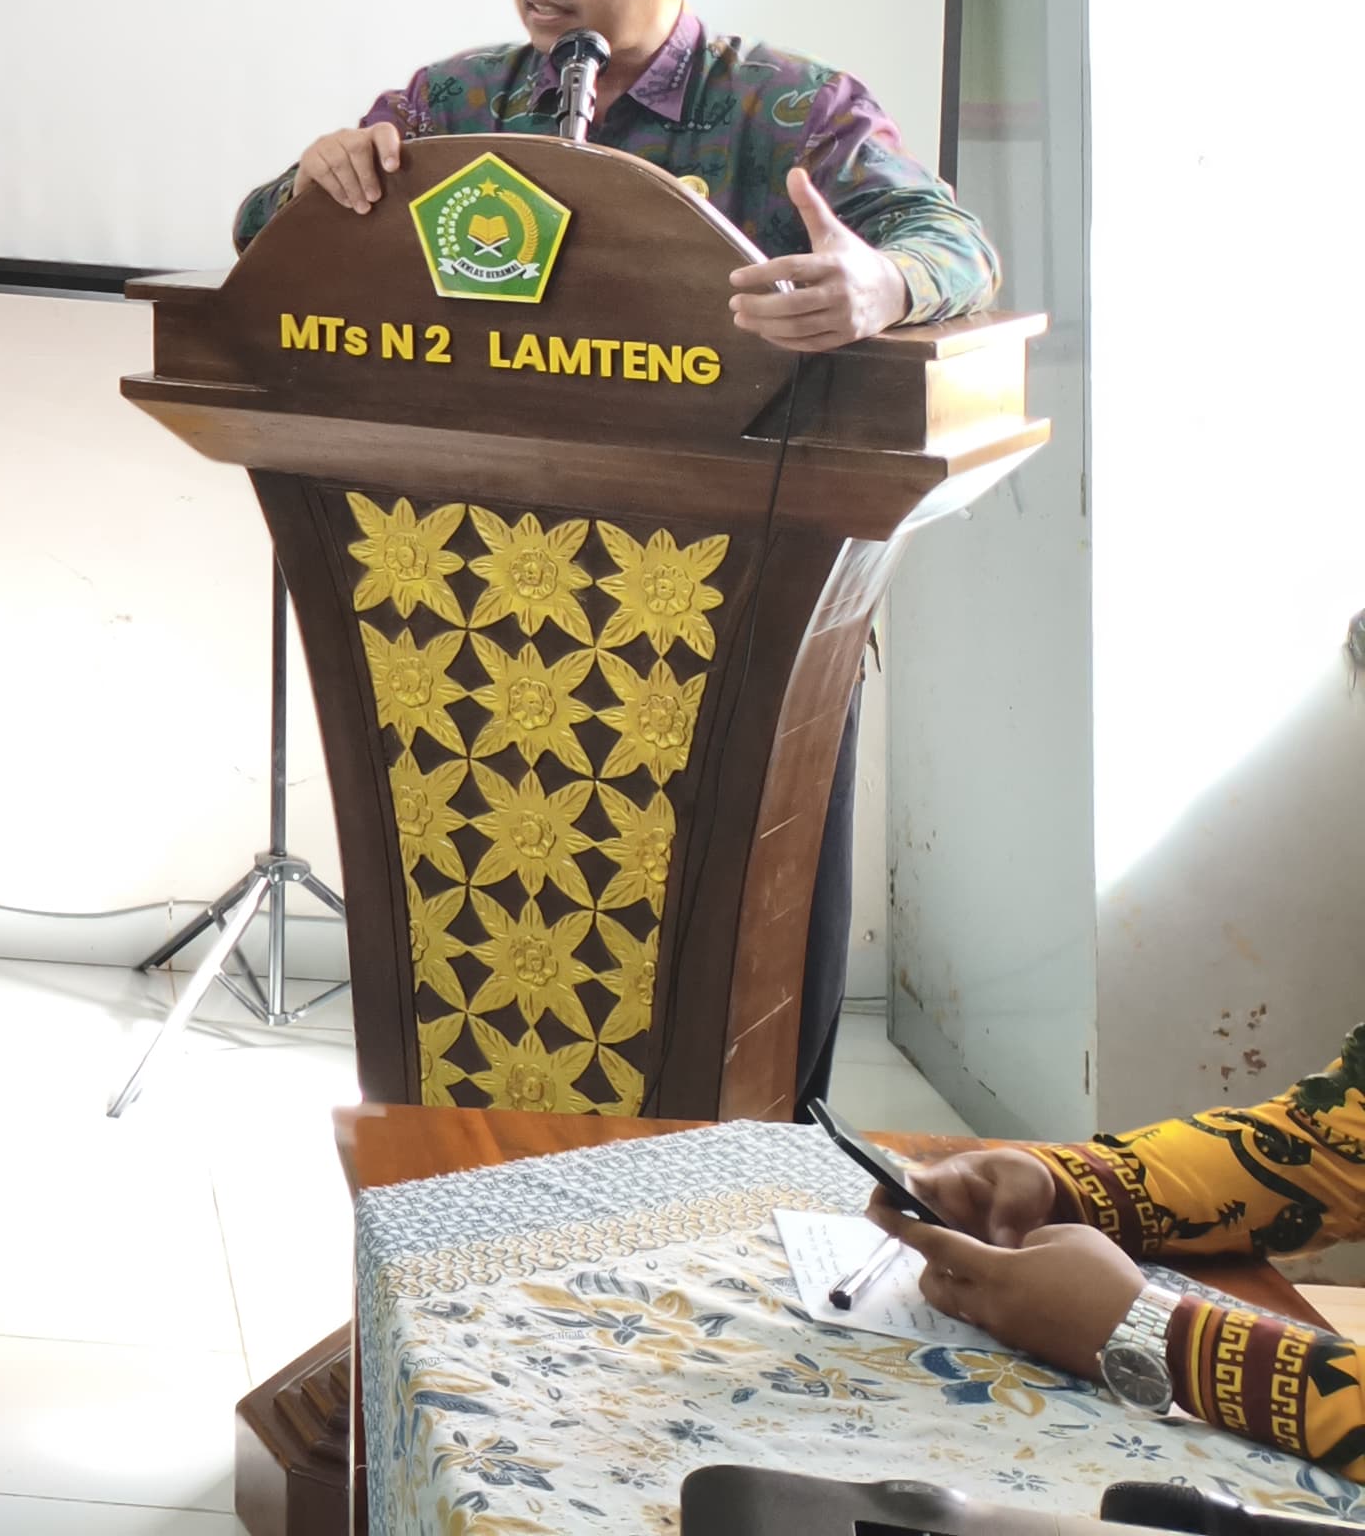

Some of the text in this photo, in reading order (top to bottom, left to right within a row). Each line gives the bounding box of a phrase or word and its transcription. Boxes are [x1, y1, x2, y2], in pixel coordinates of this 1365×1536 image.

[280, 313, 721, 385] MTs N 2 LAMTENG
